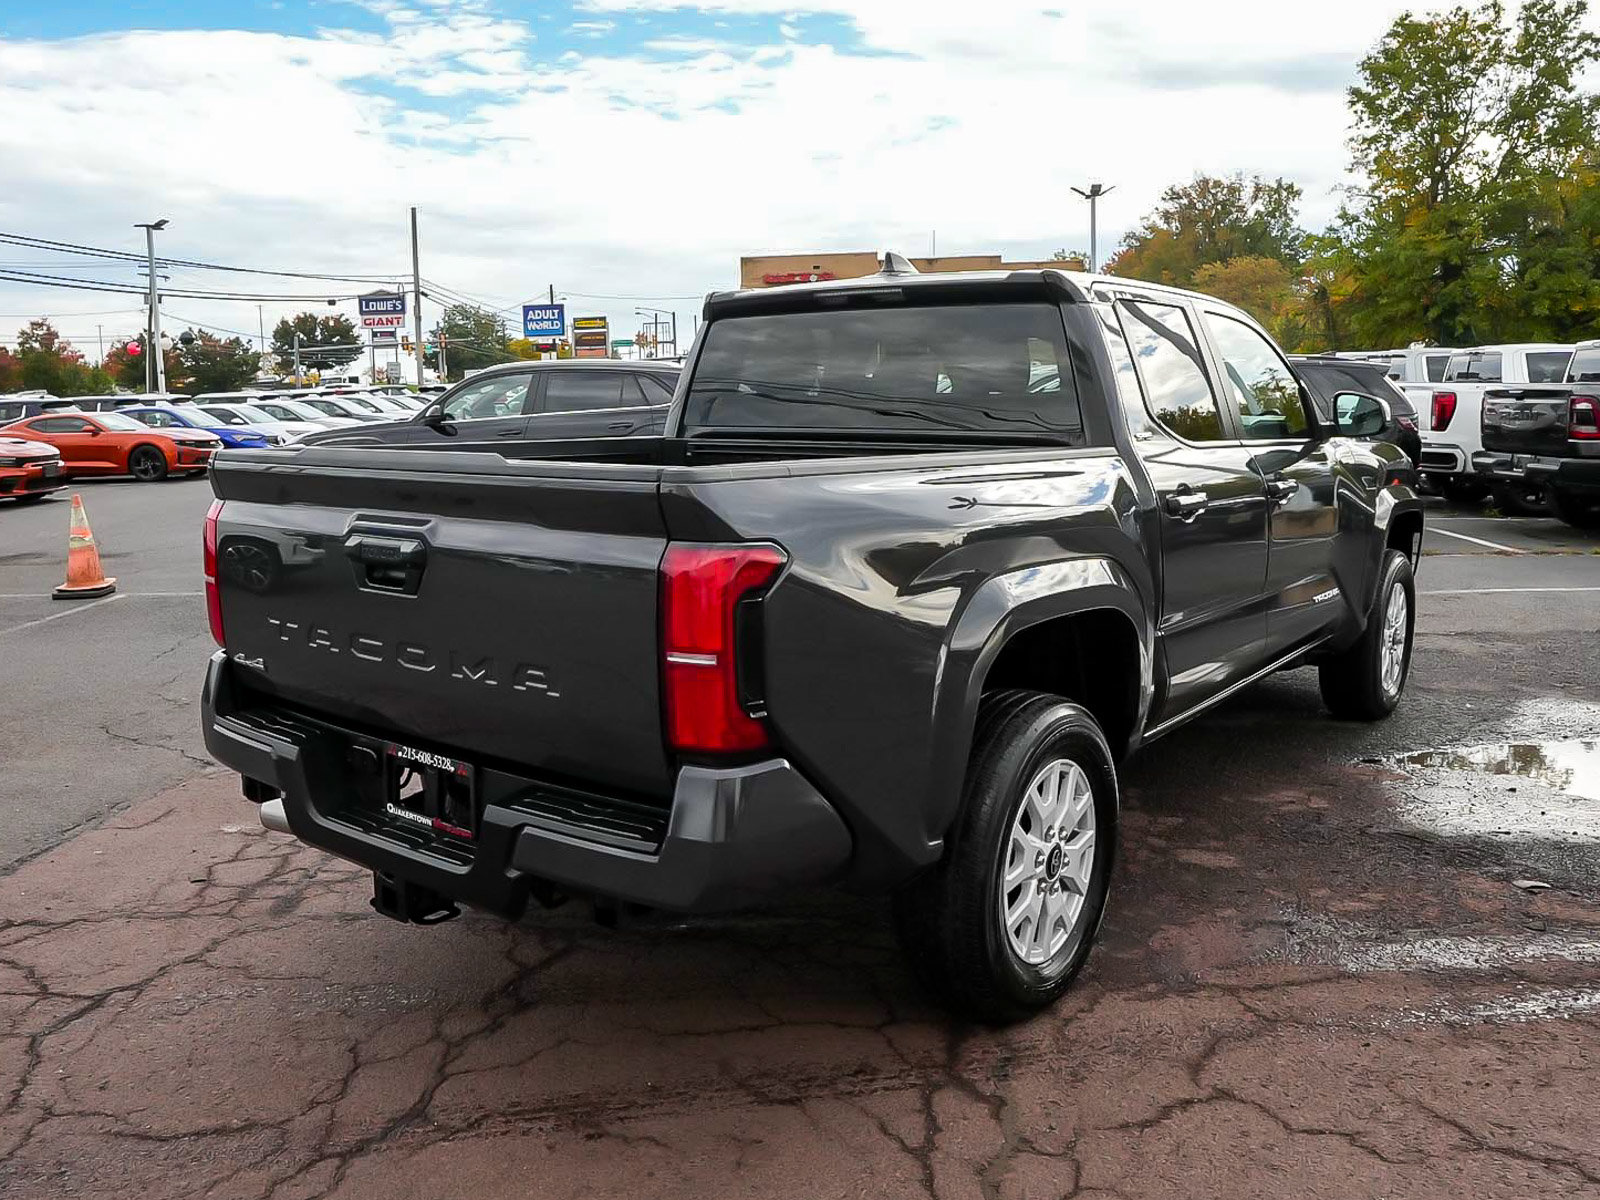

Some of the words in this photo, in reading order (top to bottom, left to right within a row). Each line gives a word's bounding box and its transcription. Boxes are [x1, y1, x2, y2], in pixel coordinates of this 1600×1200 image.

[362, 299, 402, 311] LOWE'S
[527, 309, 560, 321] ADULT
[363, 316, 402, 327] GIANT
[527, 320, 561, 331] WORLD
[266, 612, 561, 698] TACOMA
